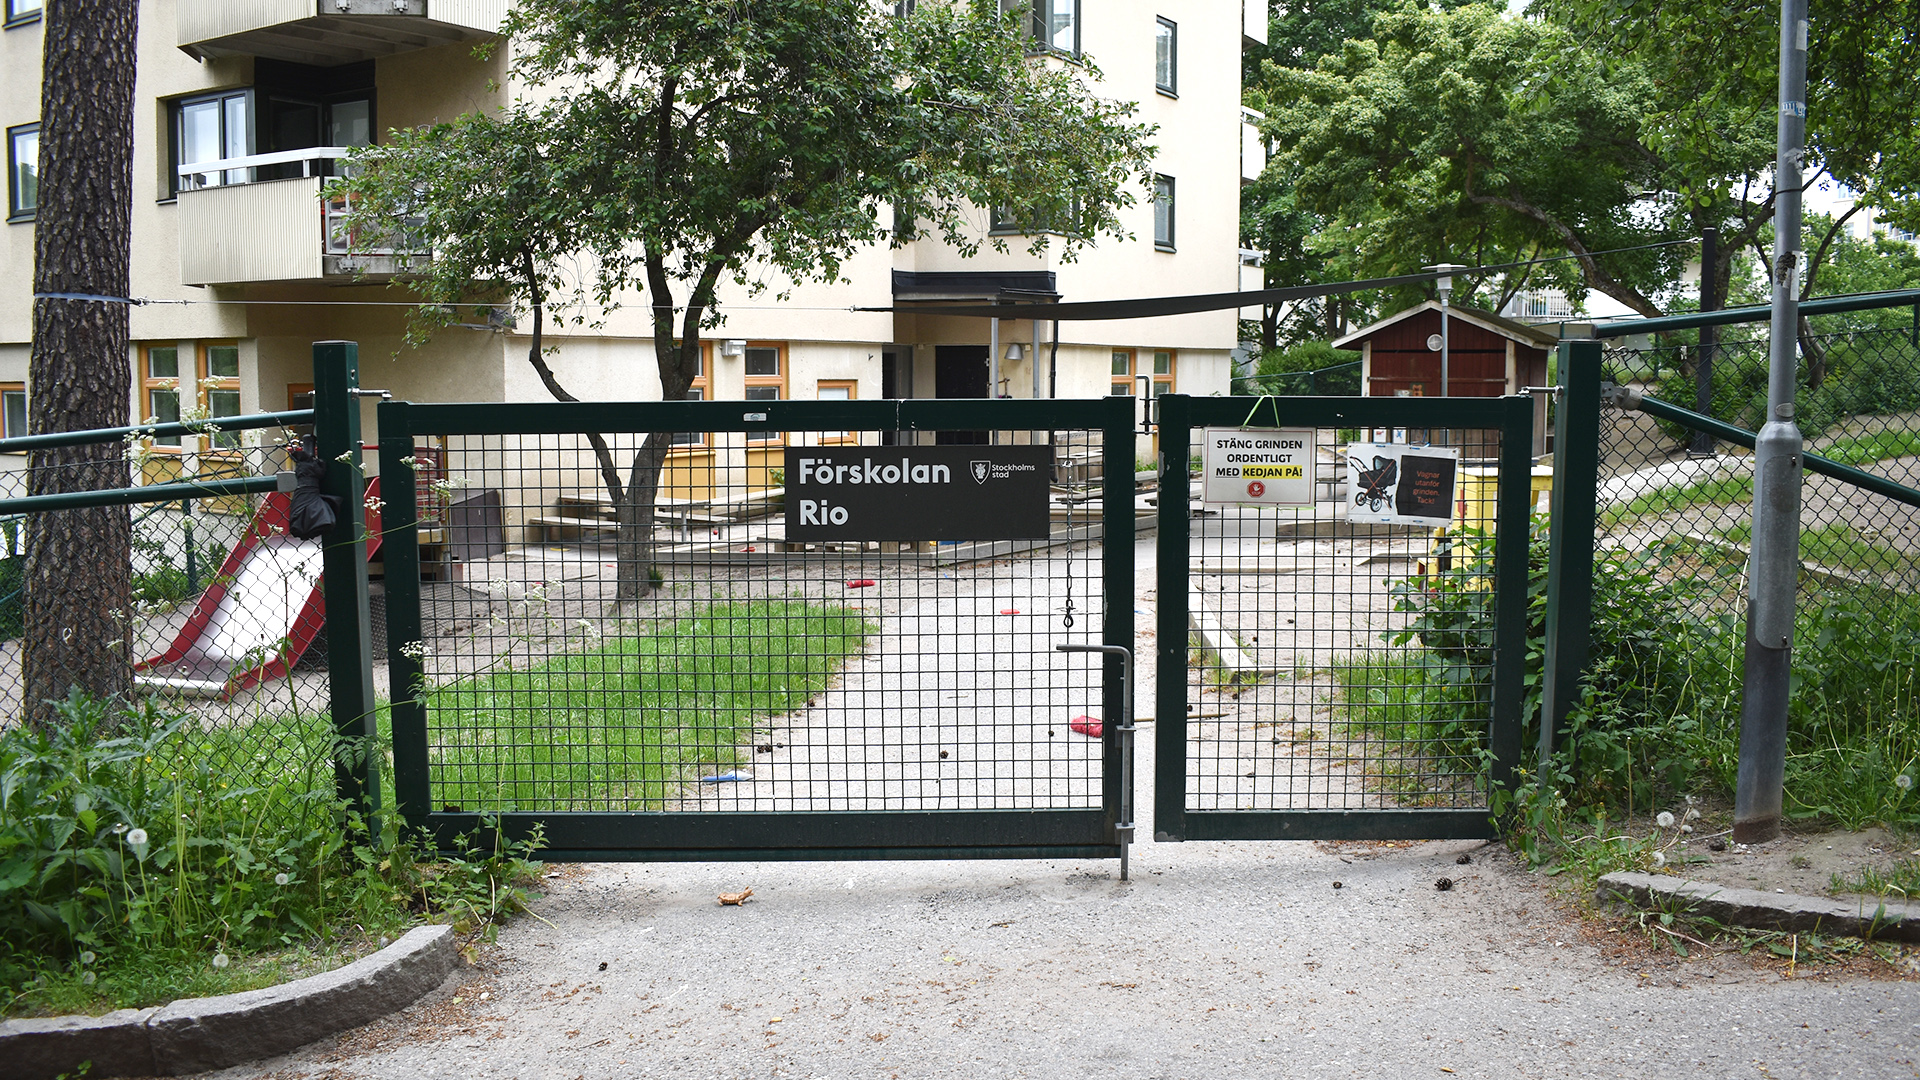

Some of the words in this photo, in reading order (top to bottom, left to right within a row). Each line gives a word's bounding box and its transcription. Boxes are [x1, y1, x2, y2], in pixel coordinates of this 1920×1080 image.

[1216, 437, 1253, 449] STÄNG
[1255, 440, 1303, 449] GRINDEN
[1227, 454, 1293, 463] ORDENTLIGT
[799, 458, 951, 484] Förskolan
[991, 463, 1036, 471] Stockholms
[991, 471, 1010, 479] stad
[1216, 467, 1240, 477] MED
[1242, 468, 1283, 478] KEDJAN
[1285, 466, 1303, 477] PÅ!
[1416, 470, 1441, 479] Vagnar
[1417, 496, 1436, 504] Tack!
[799, 499, 850, 526] Rio
